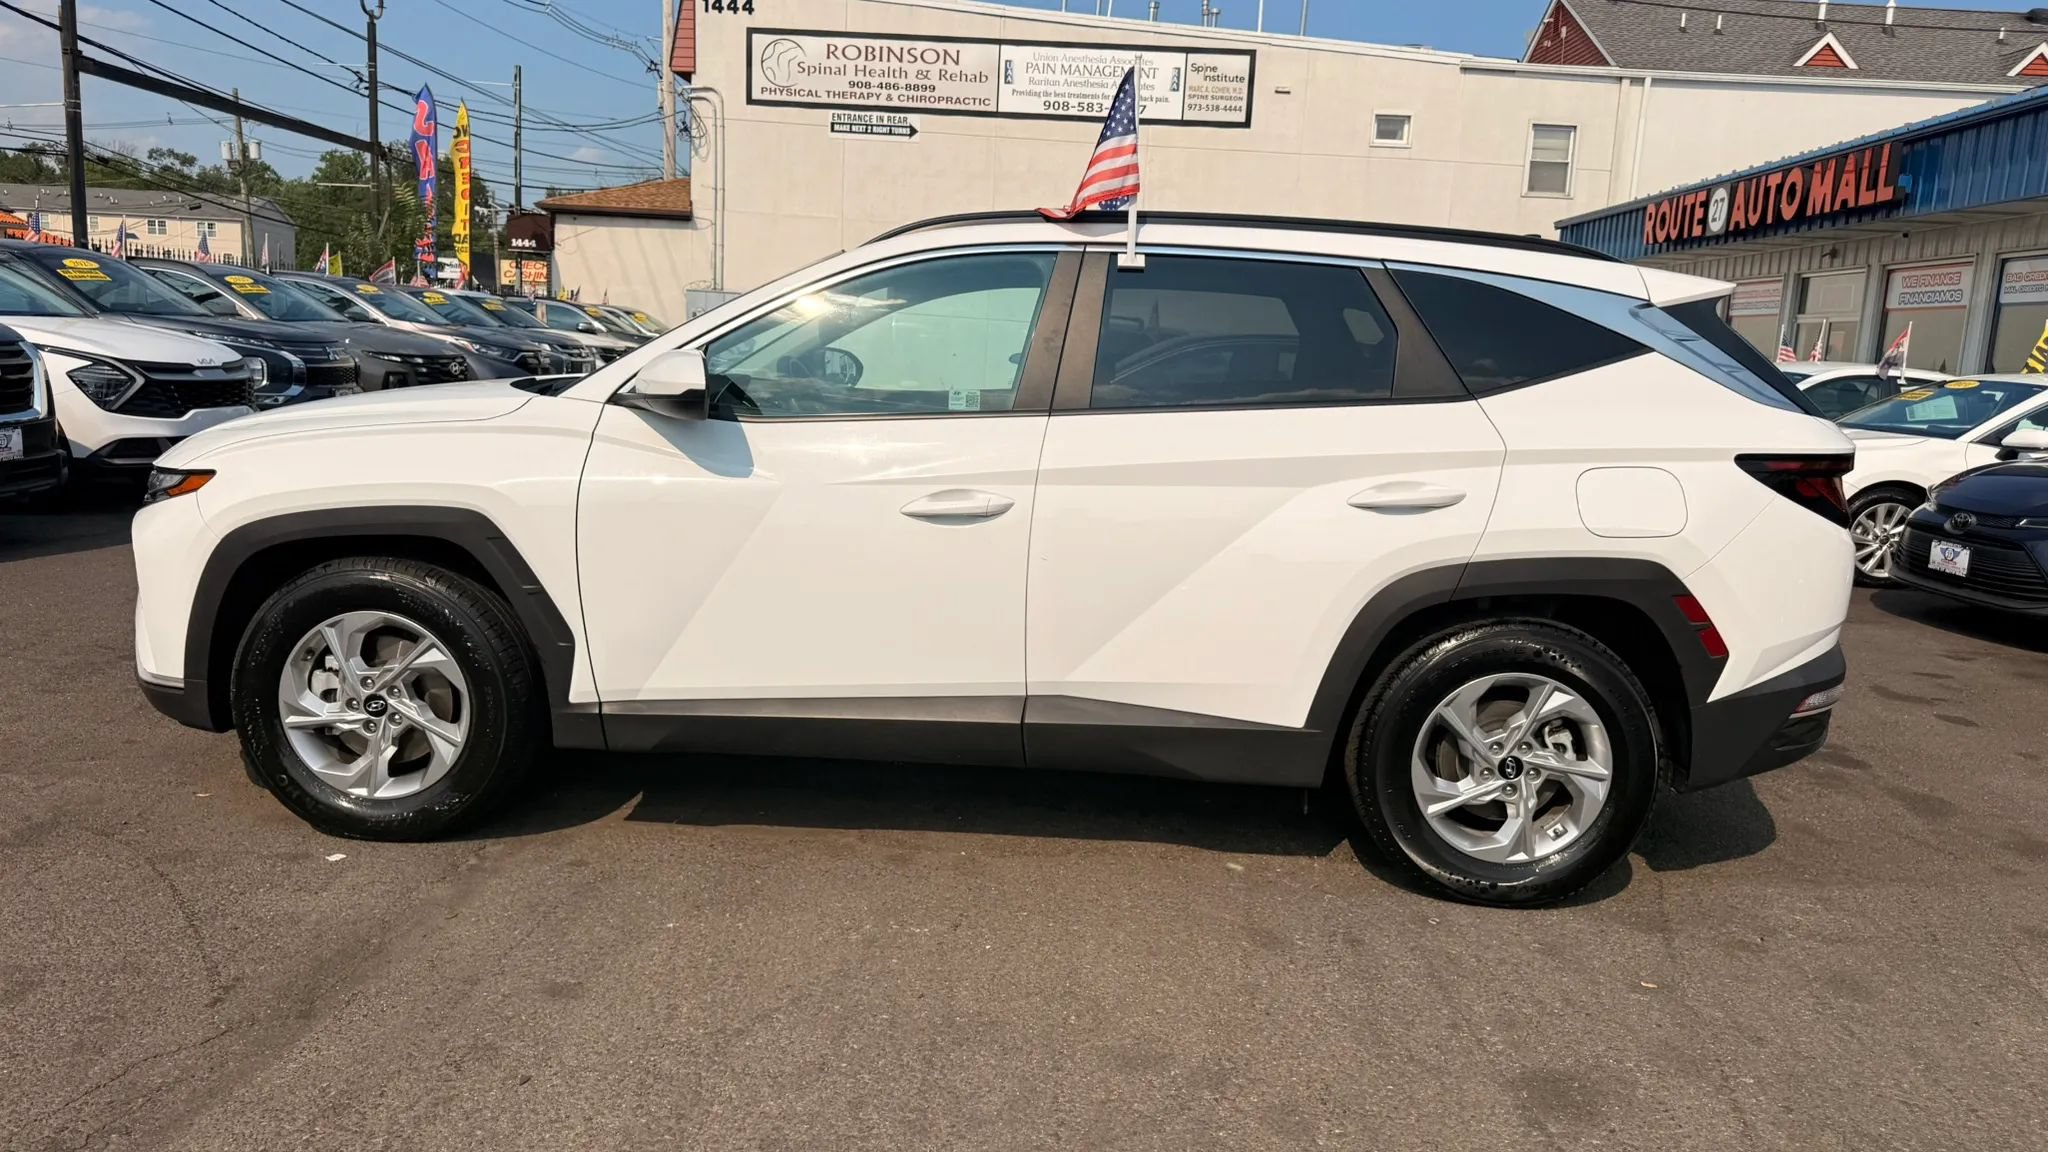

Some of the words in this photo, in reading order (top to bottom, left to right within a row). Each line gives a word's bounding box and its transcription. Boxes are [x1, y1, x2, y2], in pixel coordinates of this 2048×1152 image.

[702, 0, 755, 15] 1444
[826, 44, 961, 65] ROBINSON
[1033, 52, 1058, 62] Union
[1062, 54, 1107, 65] Anesthesia
[1110, 56, 1153, 66] Assoctes
[797, 62, 847, 77] Spinal
[854, 65, 908, 79] Health
[916, 70, 932, 81] &
[938, 69, 989, 84] Rehab
[1026, 62, 1057, 75] PAIN
[1060, 65, 1159, 80] MANAGEMNT
[1191, 63, 1218, 74] Spine
[1028, 76, 1060, 87] Raritan
[1062, 78, 1108, 89] Anesthesia
[1204, 72, 1246, 83] Institute
[848, 80, 936, 93] 908-486-8899
[760, 86, 822, 99] PHYSICAL
[825, 90, 882, 101] THERAPY
[886, 94, 893, 102] &
[898, 94, 991, 107] CHIROPRACTIC
[1012, 89, 1042, 98] Providing
[1043, 90, 1052, 98] the
[1054, 91, 1066, 99] best
[1067, 92, 1100, 100] treatments
[1043, 100, 1147, 114] 908-583-7
[1188, 104, 1243, 112] 973-538-4444
[832, 113, 873, 123] ENTRANCE
[876, 115, 885, 124] IN
[887, 116, 908, 125] REAR
[851, 125, 866, 133] NEXT
[872, 126, 890, 134] RIGHT
[891, 126, 910, 135] TURNS
[1644, 190, 1707, 245] ROUTE
[1712, 198, 1725, 223] 27
[1728, 166, 1804, 232] AUTO
[1806, 142, 1894, 217] MALL
[511, 238, 537, 248] 1444
[1902, 274, 1918, 289] WE
[1918, 272, 1962, 288] FINANCE
[2006, 272, 2024, 283] BAD
[1898, 289, 1963, 305] FINANCIAMOS
